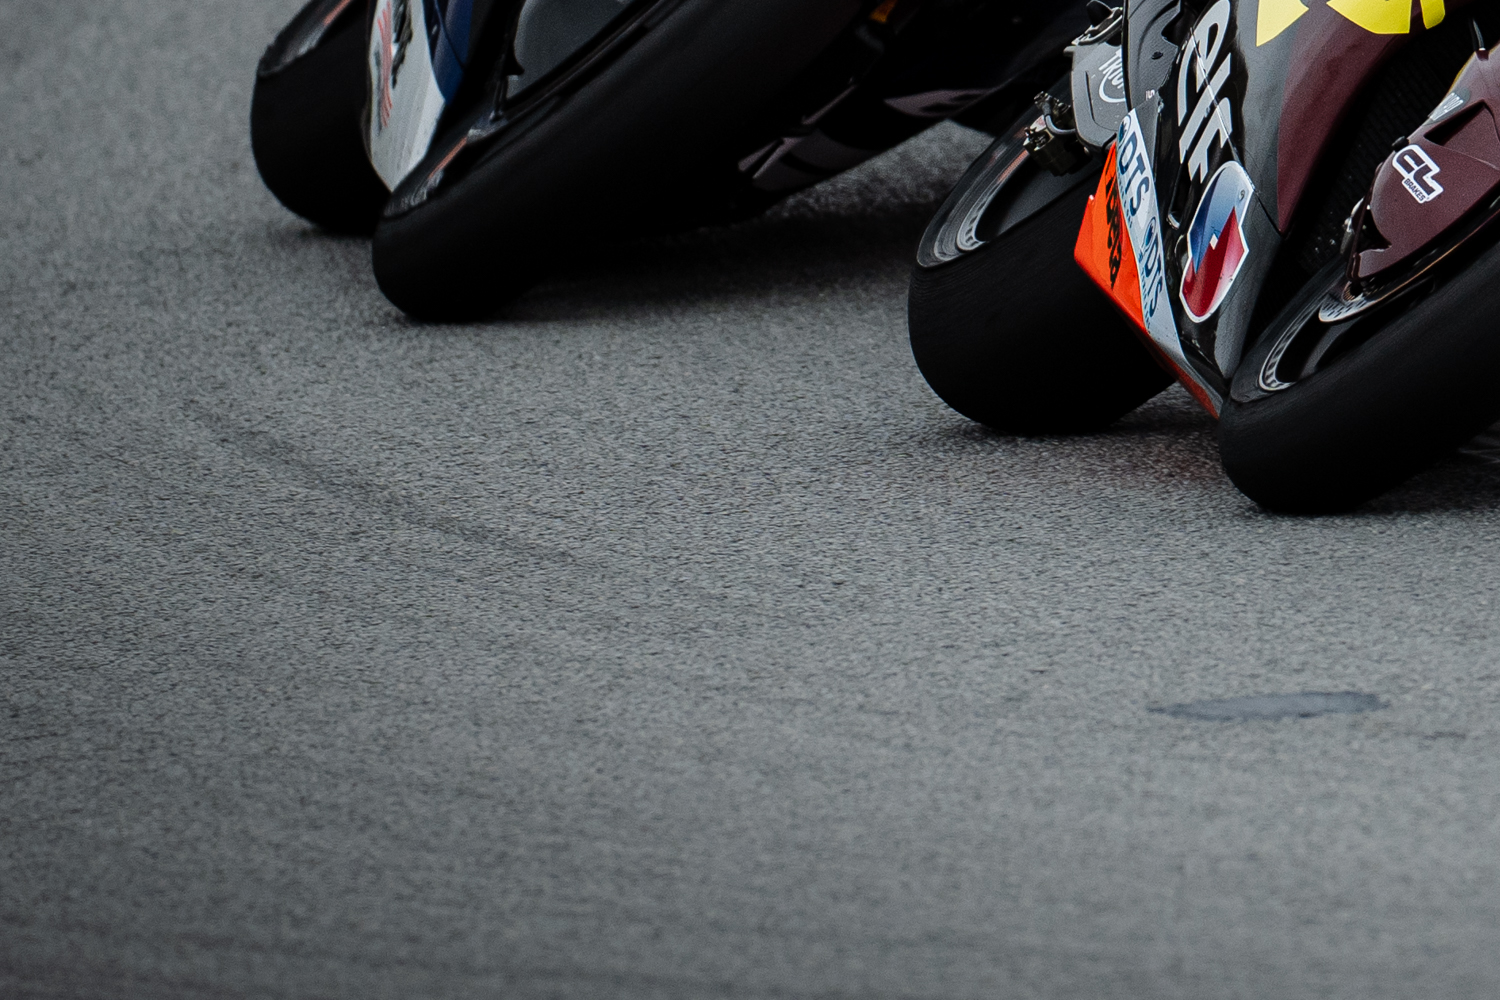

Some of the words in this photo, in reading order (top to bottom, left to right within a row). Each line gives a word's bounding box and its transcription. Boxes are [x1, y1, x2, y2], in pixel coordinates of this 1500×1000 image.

[1178, 0, 1233, 183] elf
[1120, 132, 1151, 217] DTS
[1404, 177, 1426, 202] BRAKES
